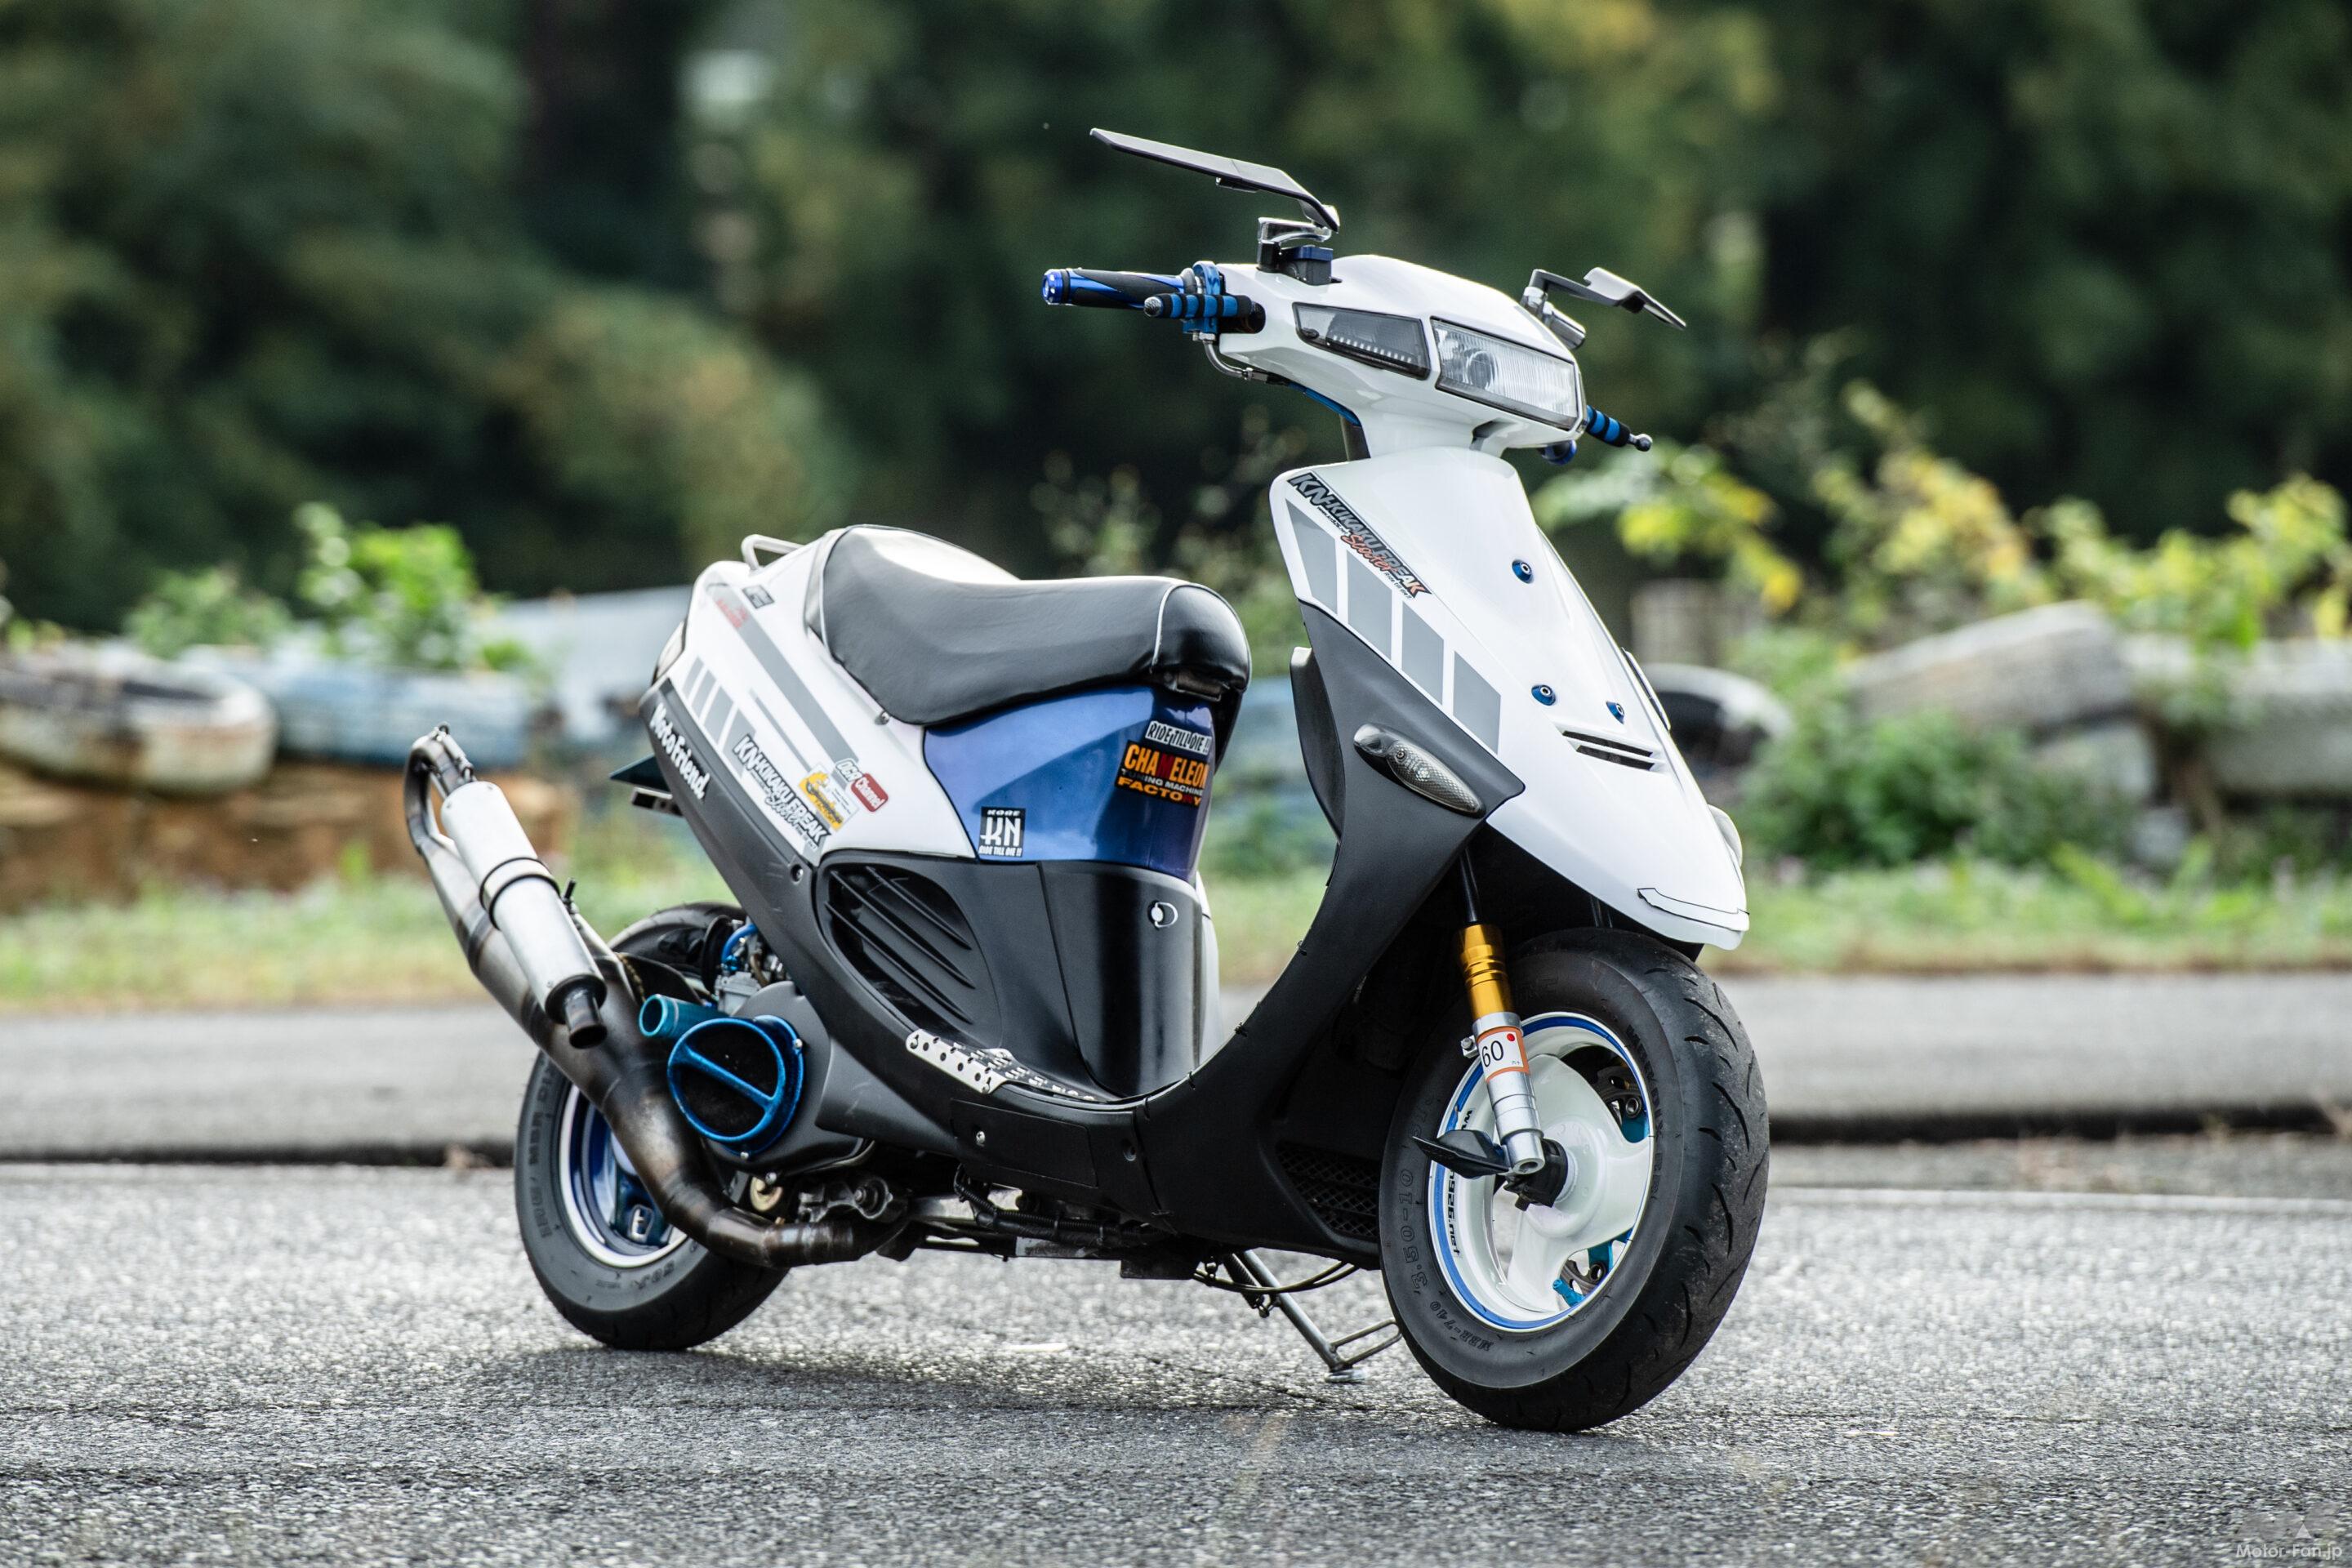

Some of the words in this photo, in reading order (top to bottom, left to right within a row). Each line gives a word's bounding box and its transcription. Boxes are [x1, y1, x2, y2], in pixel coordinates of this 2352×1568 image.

[1147, 723, 1172, 743] RIDE
[1174, 730, 1188, 747] TILL
[1188, 735, 1204, 751] DIE
[1118, 776, 1201, 805] FACTORY
[980, 817, 1021, 846] KN
[1481, 1040, 1504, 1067] 60
